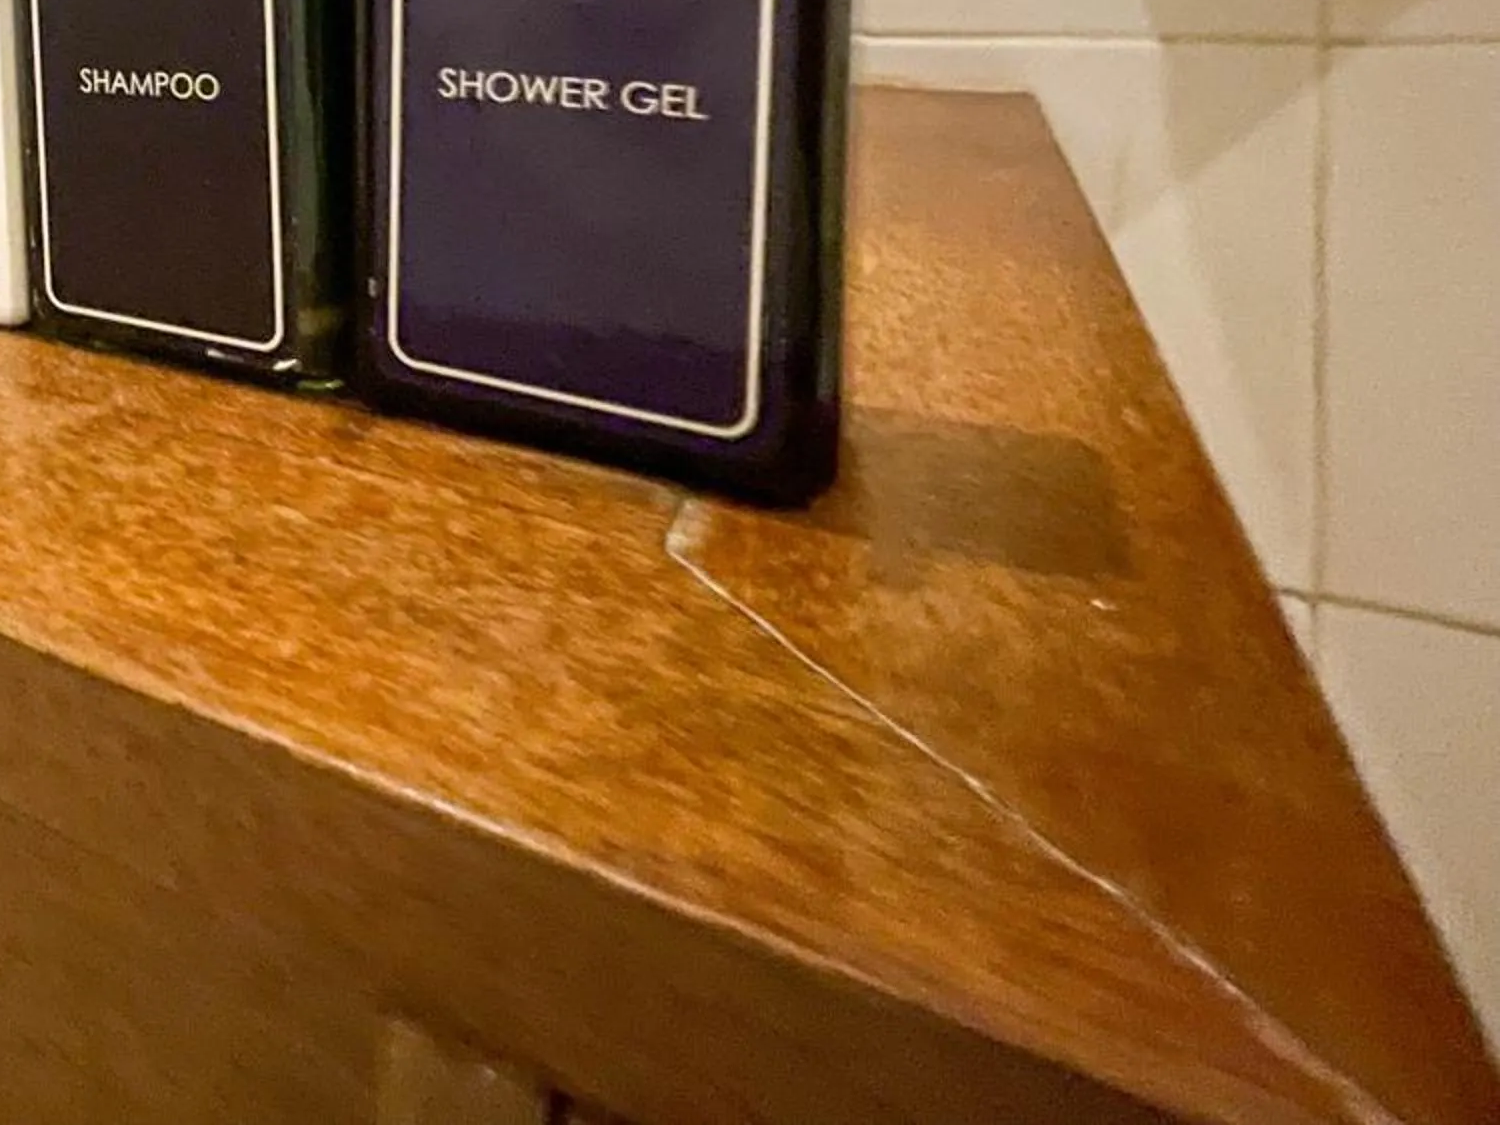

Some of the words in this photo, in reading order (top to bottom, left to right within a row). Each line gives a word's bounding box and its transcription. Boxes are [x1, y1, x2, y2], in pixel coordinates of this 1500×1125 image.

[79, 67, 221, 101] SHAMPOO
[437, 67, 609, 110] SHOWER
[619, 81, 711, 121] GEL
